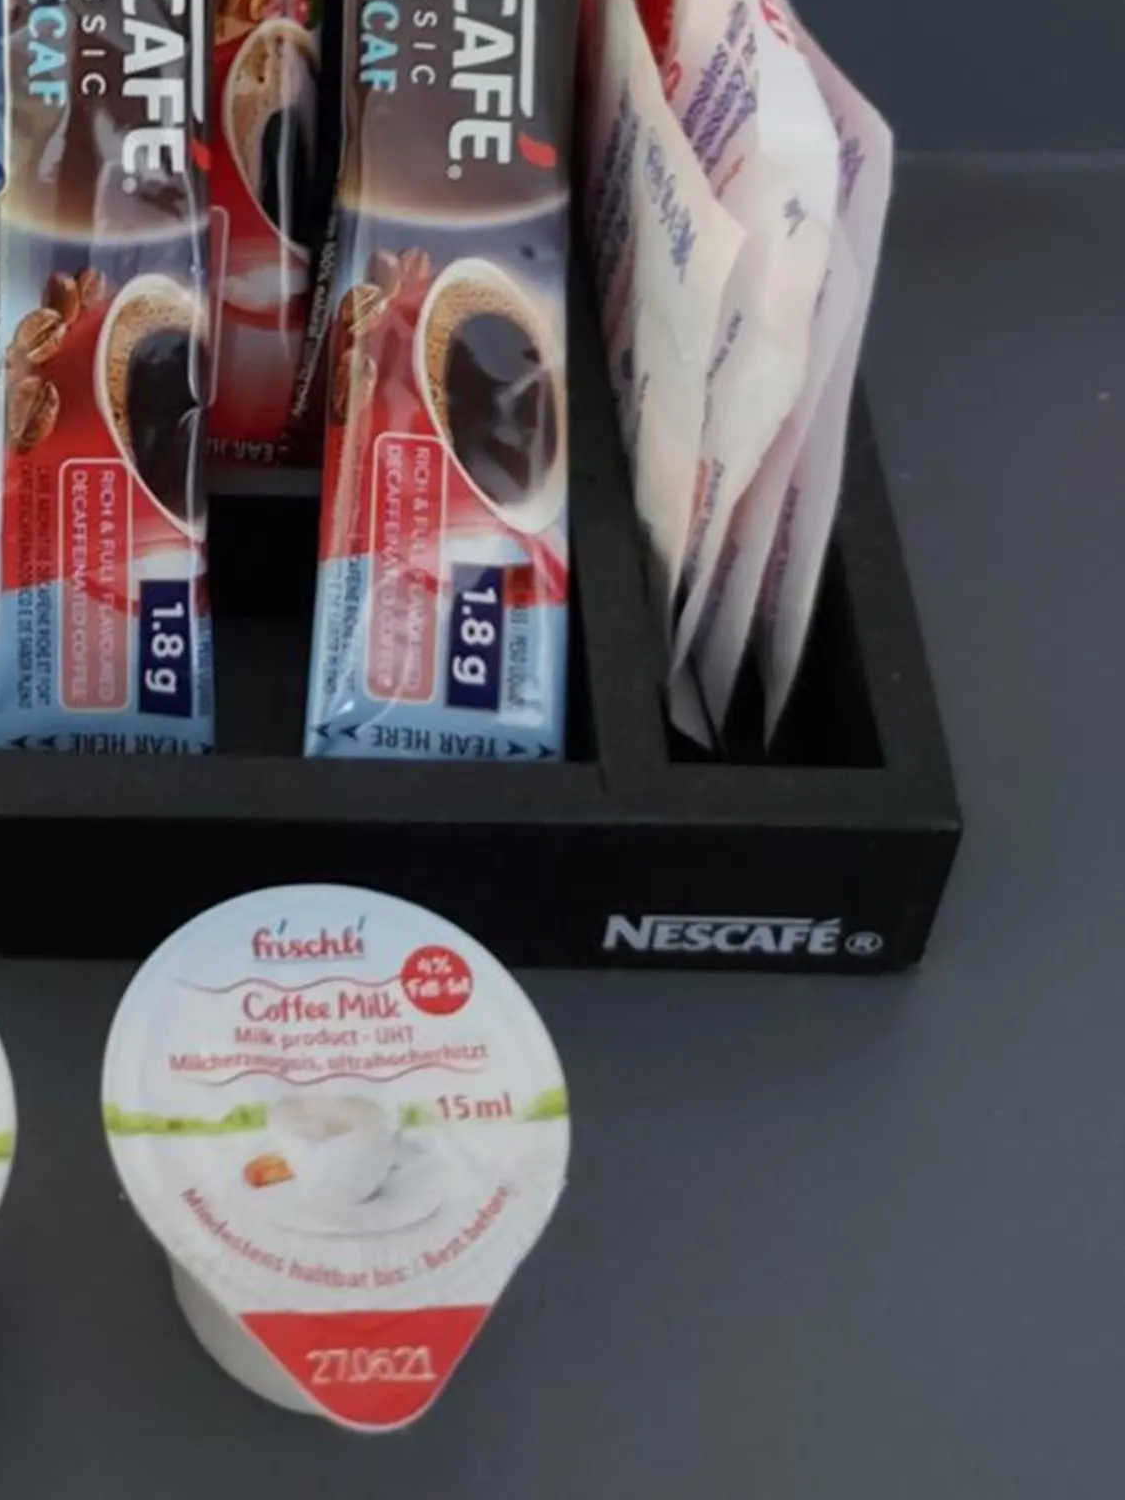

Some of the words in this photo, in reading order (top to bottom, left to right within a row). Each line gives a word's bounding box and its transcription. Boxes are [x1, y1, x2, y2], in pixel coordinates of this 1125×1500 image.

[412, 446, 431, 493] RICH
[98, 469, 116, 515] RICH
[411, 496, 430, 513] &
[98, 519, 116, 534] &
[97, 539, 116, 584] FULL
[151, 601, 185, 659] 1.8
[461, 585, 497, 646] 1.8
[145, 668, 177, 695] g
[452, 655, 488, 687] g
[369, 724, 431, 751] HERE
[438, 731, 498, 758] TEAR
[602, 913, 843, 955] NESCAFÉ
[241, 991, 331, 1024] Coffee
[336, 990, 404, 1020] Milk
[233, 1026, 276, 1046] Milk
[280, 1027, 359, 1050] product
[374, 1025, 415, 1046] UHT
[434, 1094, 472, 1121] 15
[474, 1091, 514, 1119] ml
